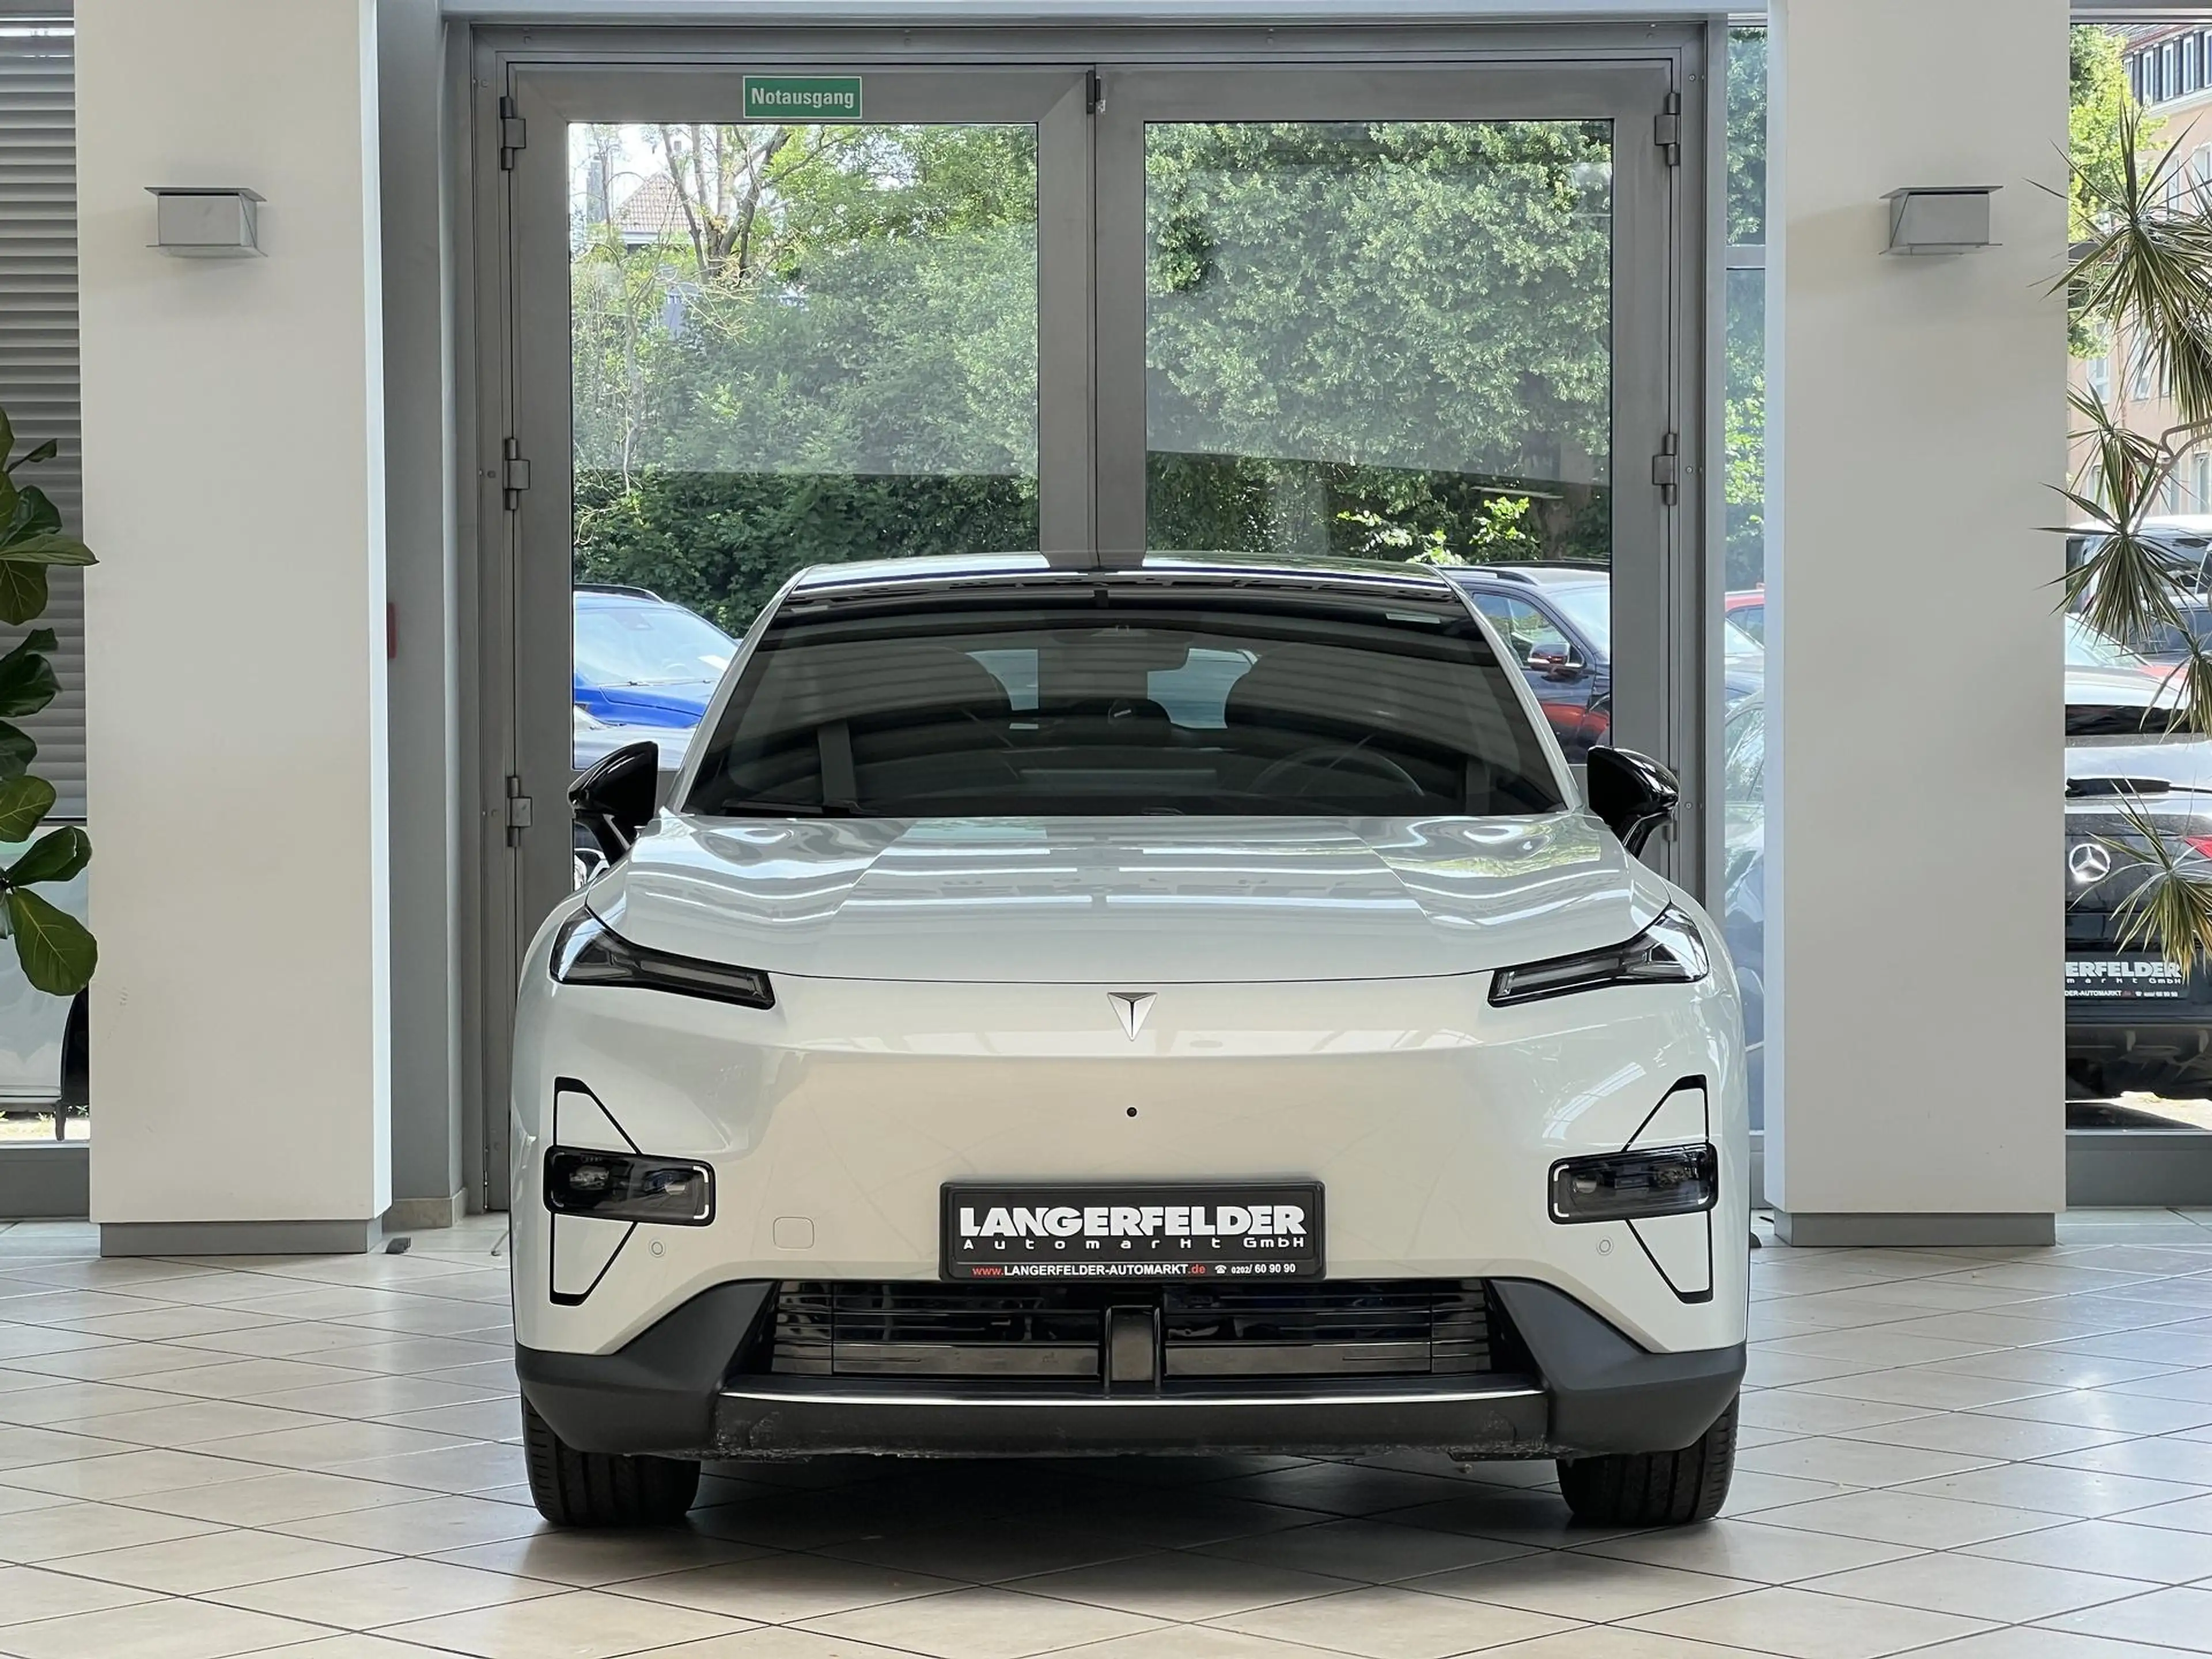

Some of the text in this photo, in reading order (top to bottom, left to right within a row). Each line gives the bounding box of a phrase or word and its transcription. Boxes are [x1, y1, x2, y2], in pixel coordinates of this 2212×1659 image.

[751, 88, 854, 109] Notausgang
[960, 1206, 1307, 1236] LANGERFELDER
[1244, 1237, 1304, 1248] GmbH
[972, 1263, 1296, 1277] www.LANGERFELDER-AUTOMARKT.de 0202/ 60 90 90
